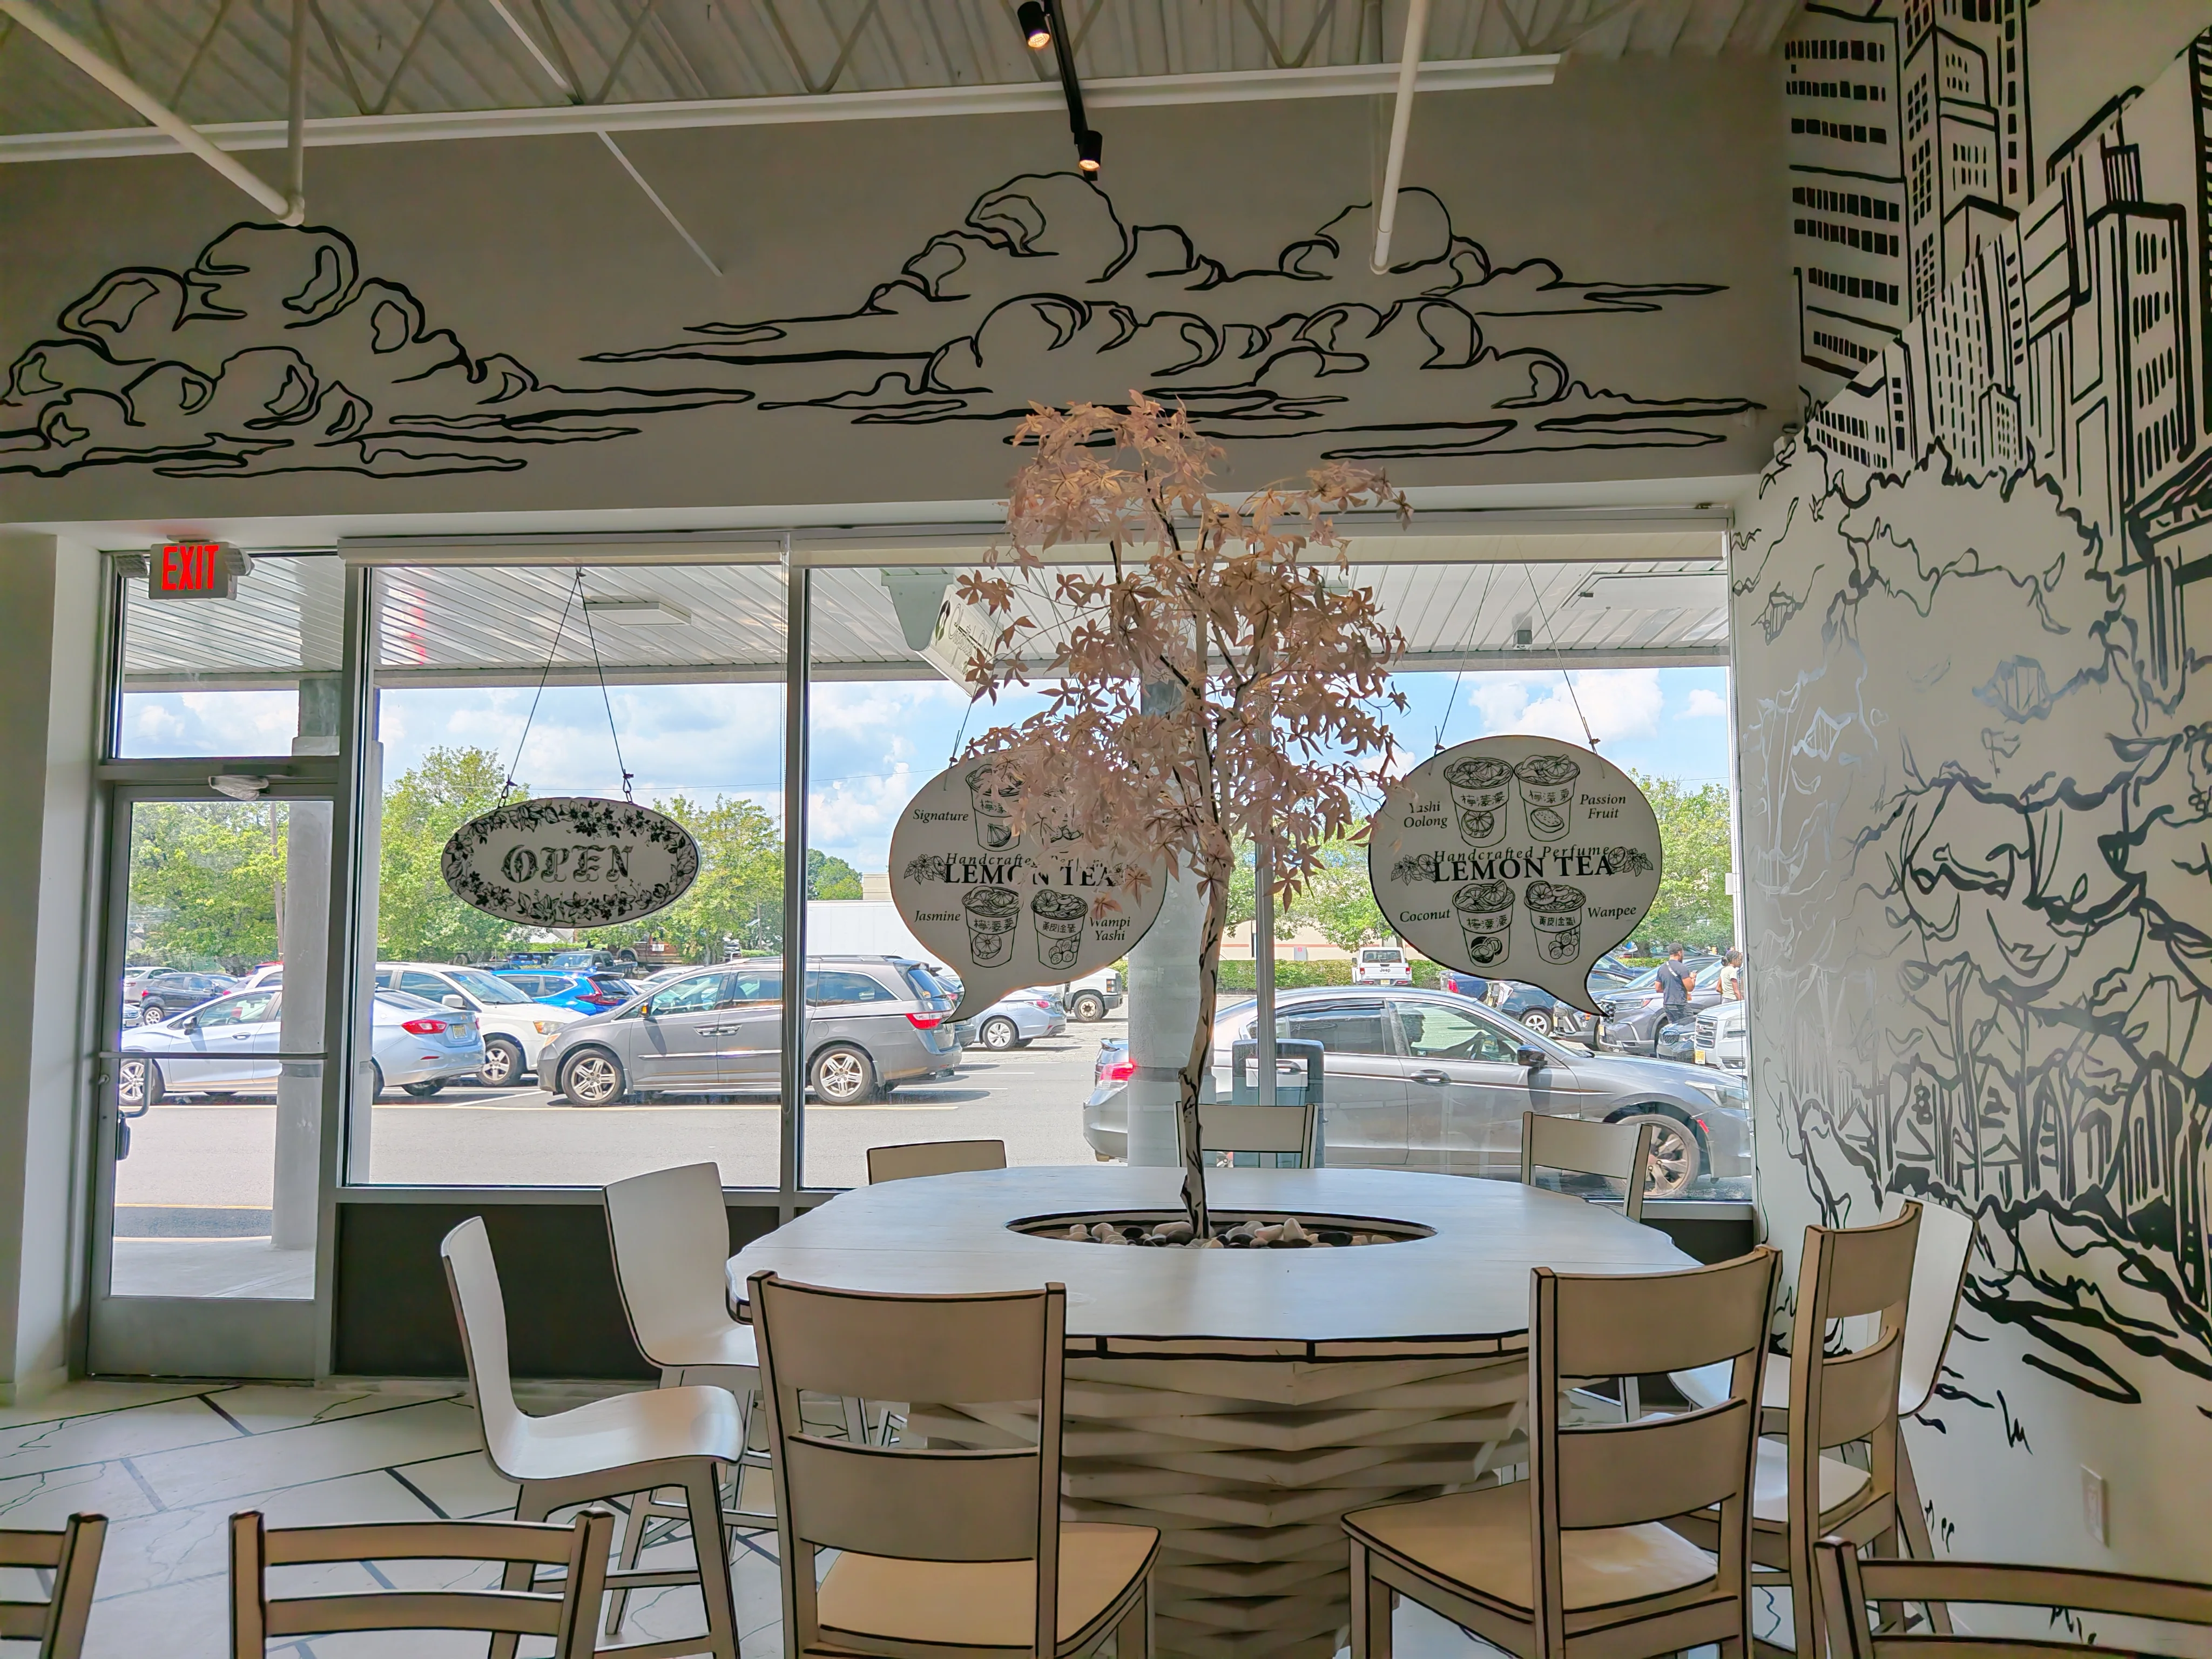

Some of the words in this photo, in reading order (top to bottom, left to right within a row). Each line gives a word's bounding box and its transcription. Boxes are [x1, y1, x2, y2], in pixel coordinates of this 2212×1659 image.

[161, 544, 219, 590] EXIT
[1580, 793, 1626, 805] Passion
[913, 809, 969, 824] Signature
[1588, 807, 1620, 819] Fruit
[1404, 815, 1448, 828] Oolong
[1434, 847, 1533, 862] Handcrafted
[1542, 844, 1610, 860] Perfume
[501, 844, 634, 884] OPEN
[1433, 858, 1545, 882] LEMON
[1554, 855, 1613, 876] TEA
[914, 911, 961, 922] Jasmine
[1400, 909, 1451, 922] Coconut
[1588, 906, 1637, 919] Wanpee
[1089, 916, 1131, 928] Wampi
[1095, 929, 1125, 941] Yashi
